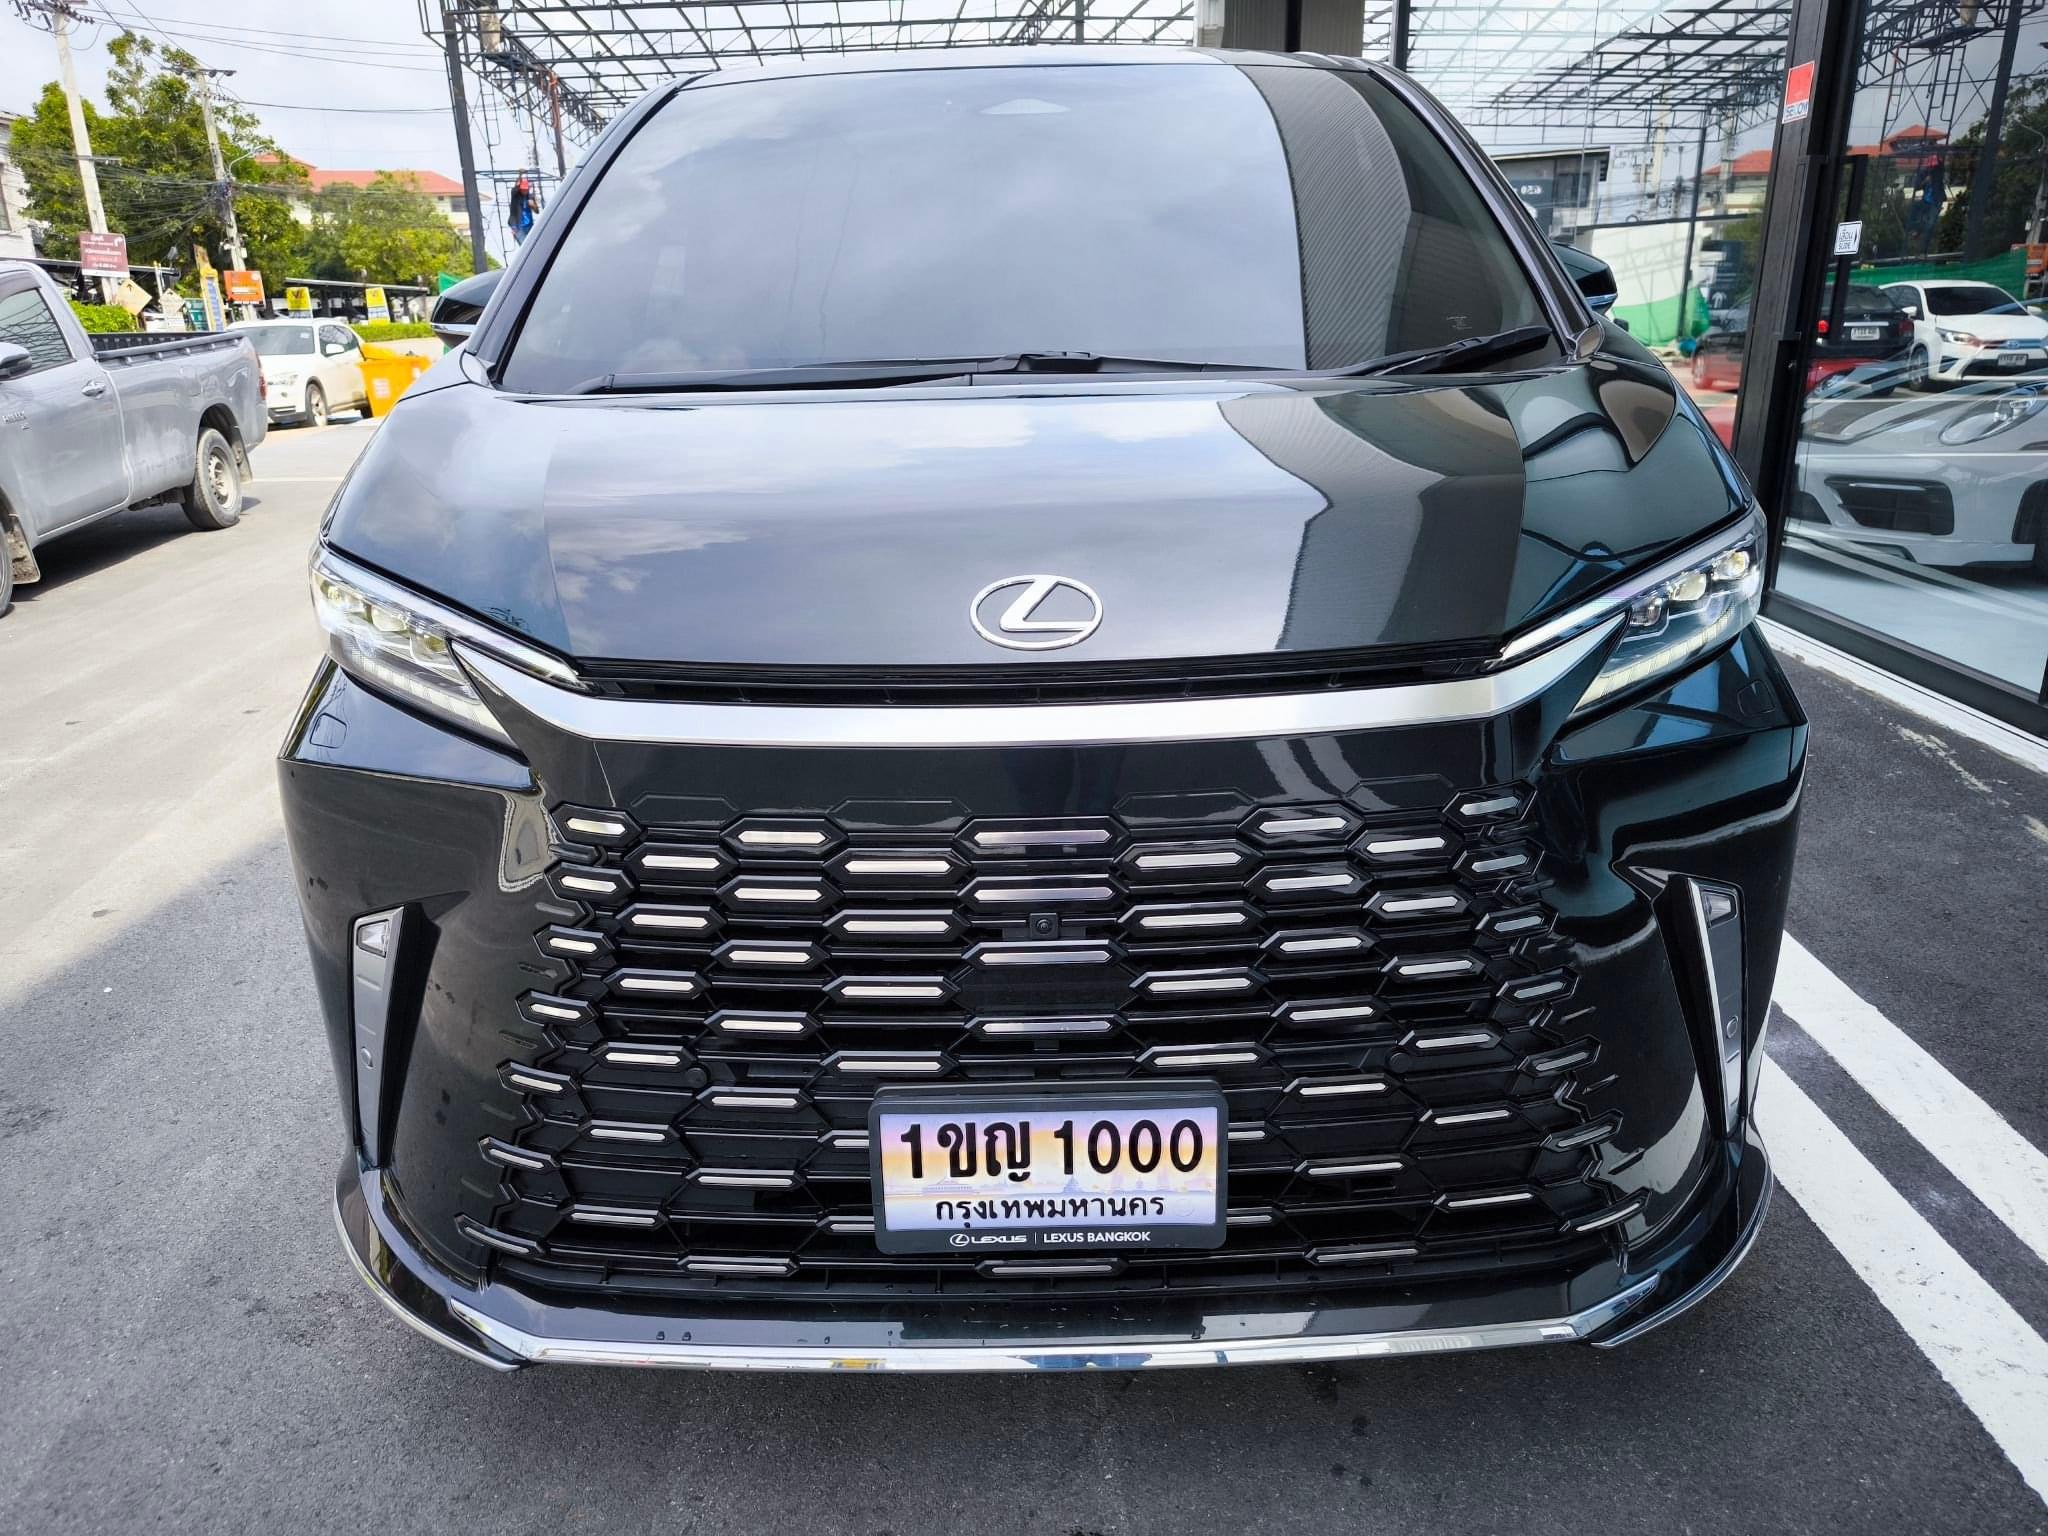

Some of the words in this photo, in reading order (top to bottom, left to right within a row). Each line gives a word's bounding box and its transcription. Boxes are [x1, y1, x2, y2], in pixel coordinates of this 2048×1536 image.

[900, 1121, 1031, 1182] 1ขญ
[1053, 1119, 1203, 1175] 1000
[935, 1196, 1165, 1228] กรุงเทพมหานคร
[971, 1234, 1027, 1244] LEXUS
[1043, 1232, 1084, 1243] LEXUS
[1087, 1231, 1151, 1243] BANGKOK
